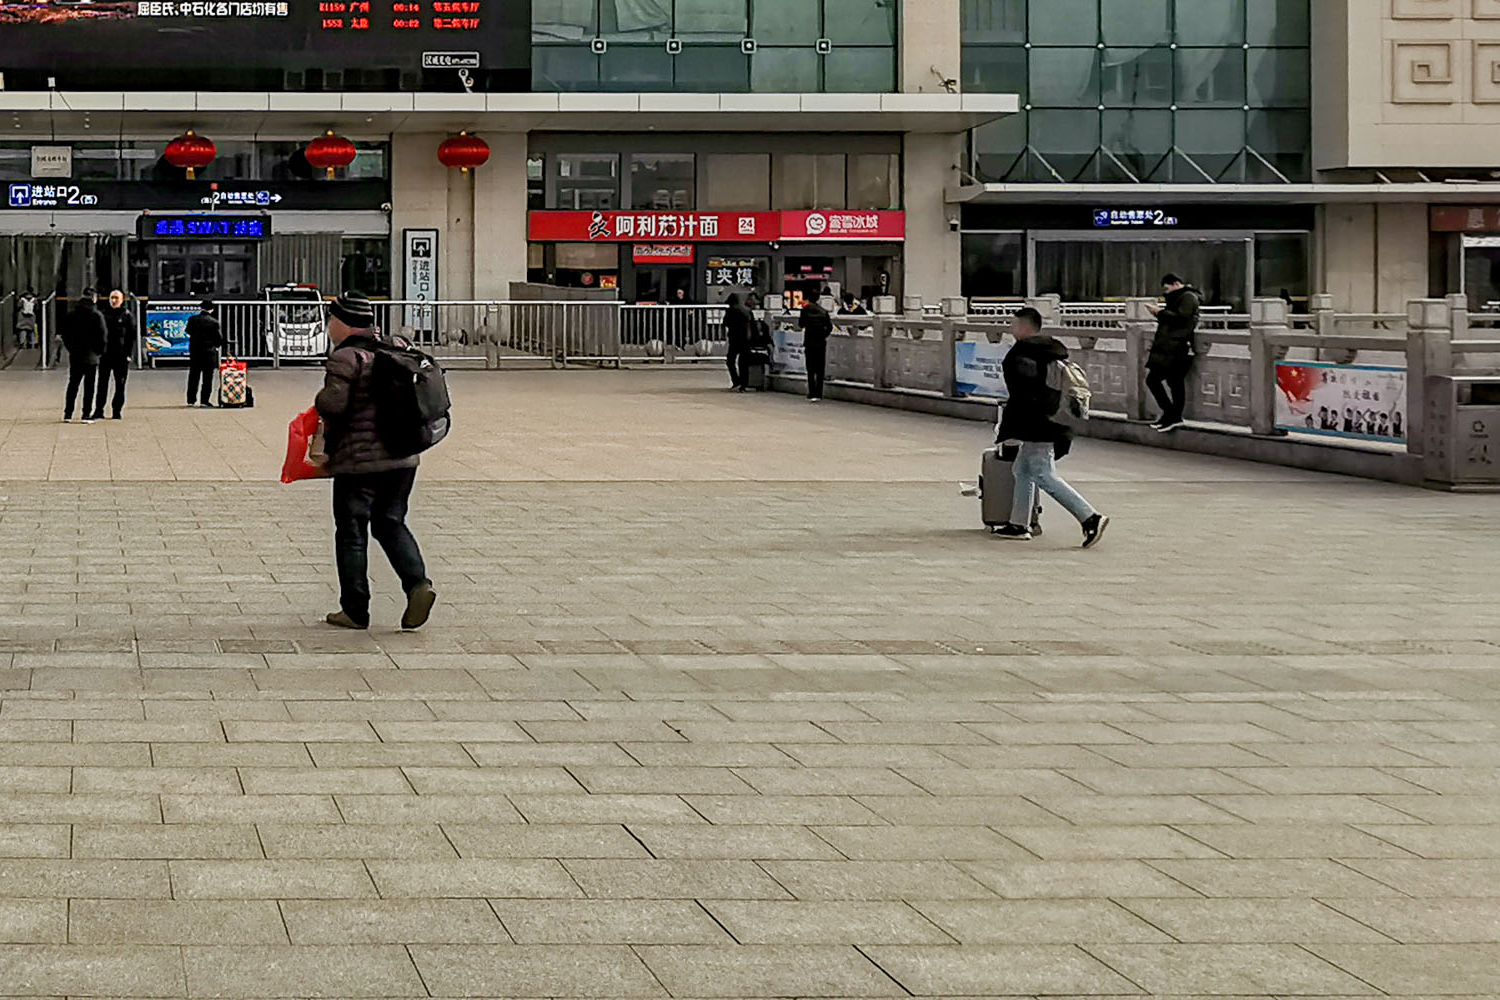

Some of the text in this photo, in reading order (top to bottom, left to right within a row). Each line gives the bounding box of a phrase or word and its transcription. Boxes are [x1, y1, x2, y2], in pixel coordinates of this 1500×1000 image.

[615, 214, 719, 237] 阿利茄汁面
[829, 215, 879, 229] 蜜雪冰城
